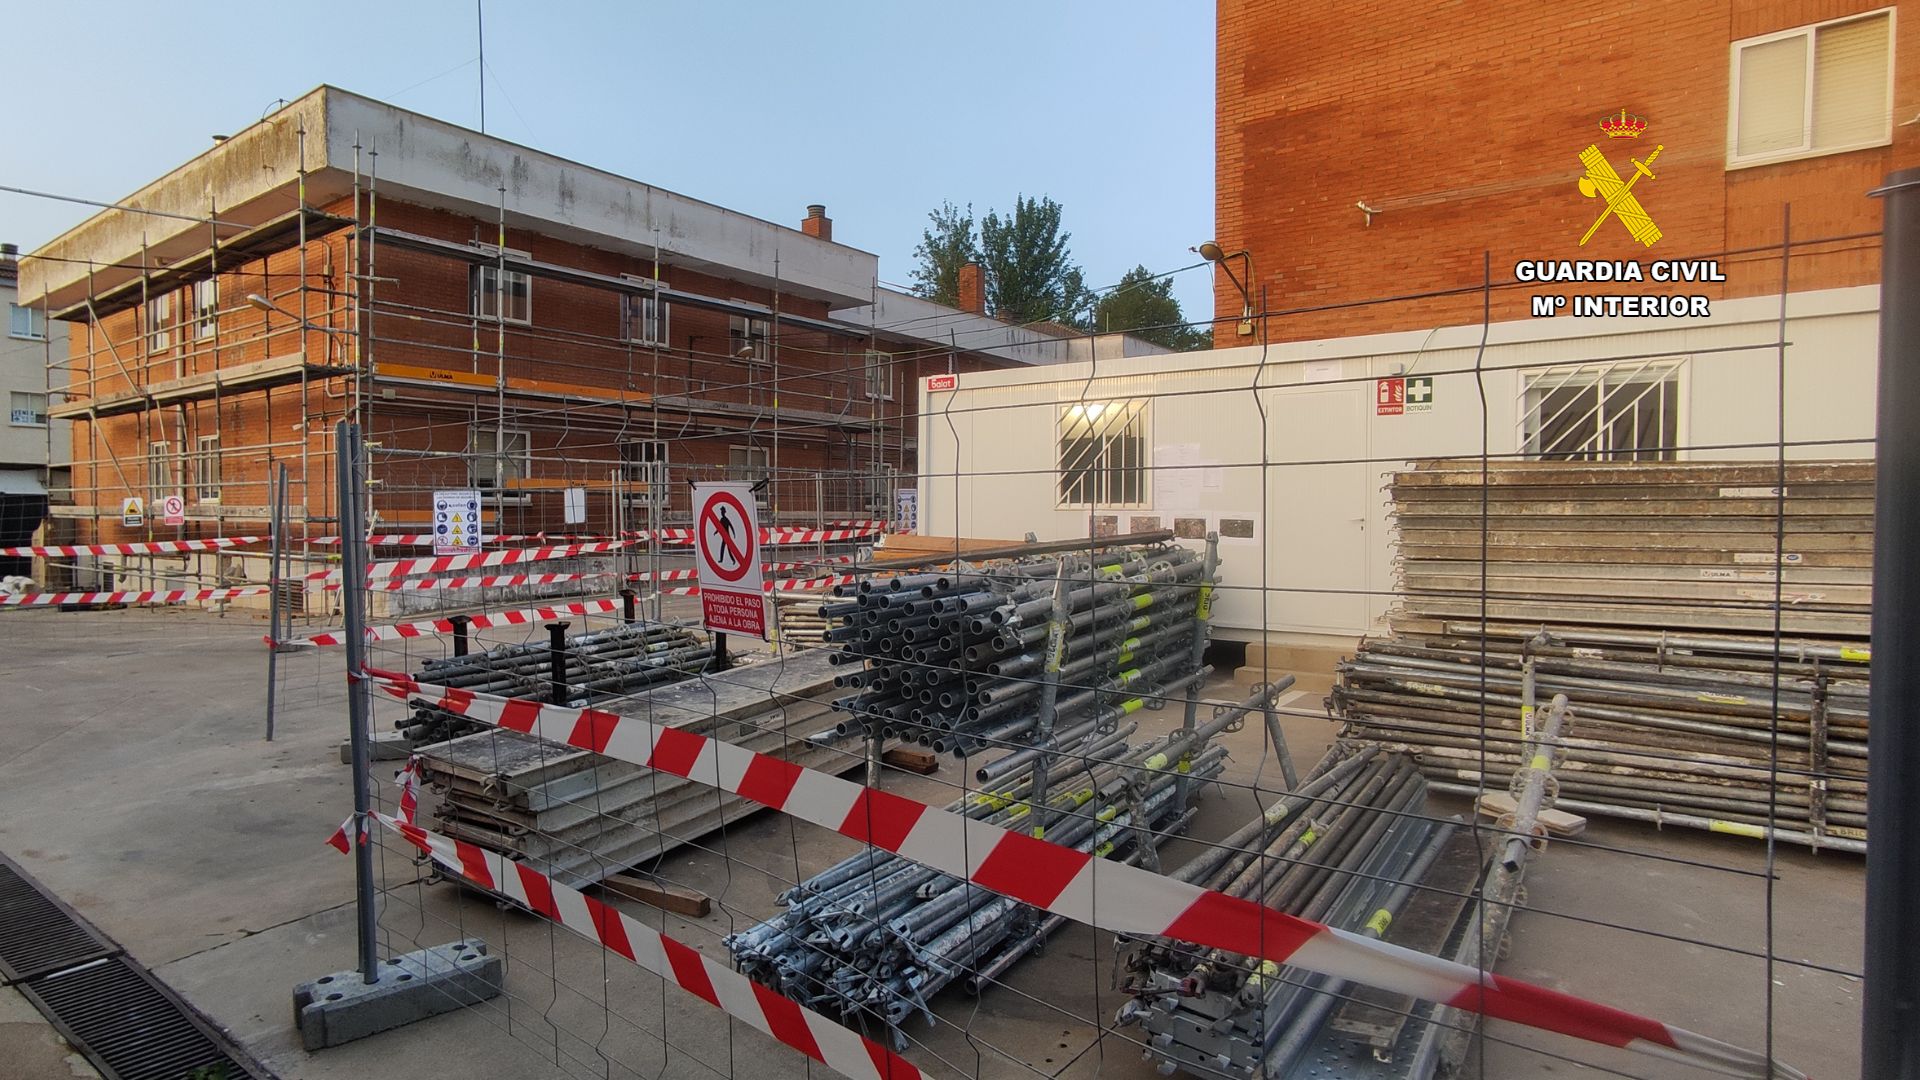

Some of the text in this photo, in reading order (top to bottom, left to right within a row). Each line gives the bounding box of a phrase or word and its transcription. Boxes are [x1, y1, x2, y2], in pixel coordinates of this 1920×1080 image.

[703, 592, 761, 608] PROHIBIDO EL PASO
[708, 603, 758, 619] A TODA PERSONA
[709, 614, 760, 630] AJENA A LA OBRA
